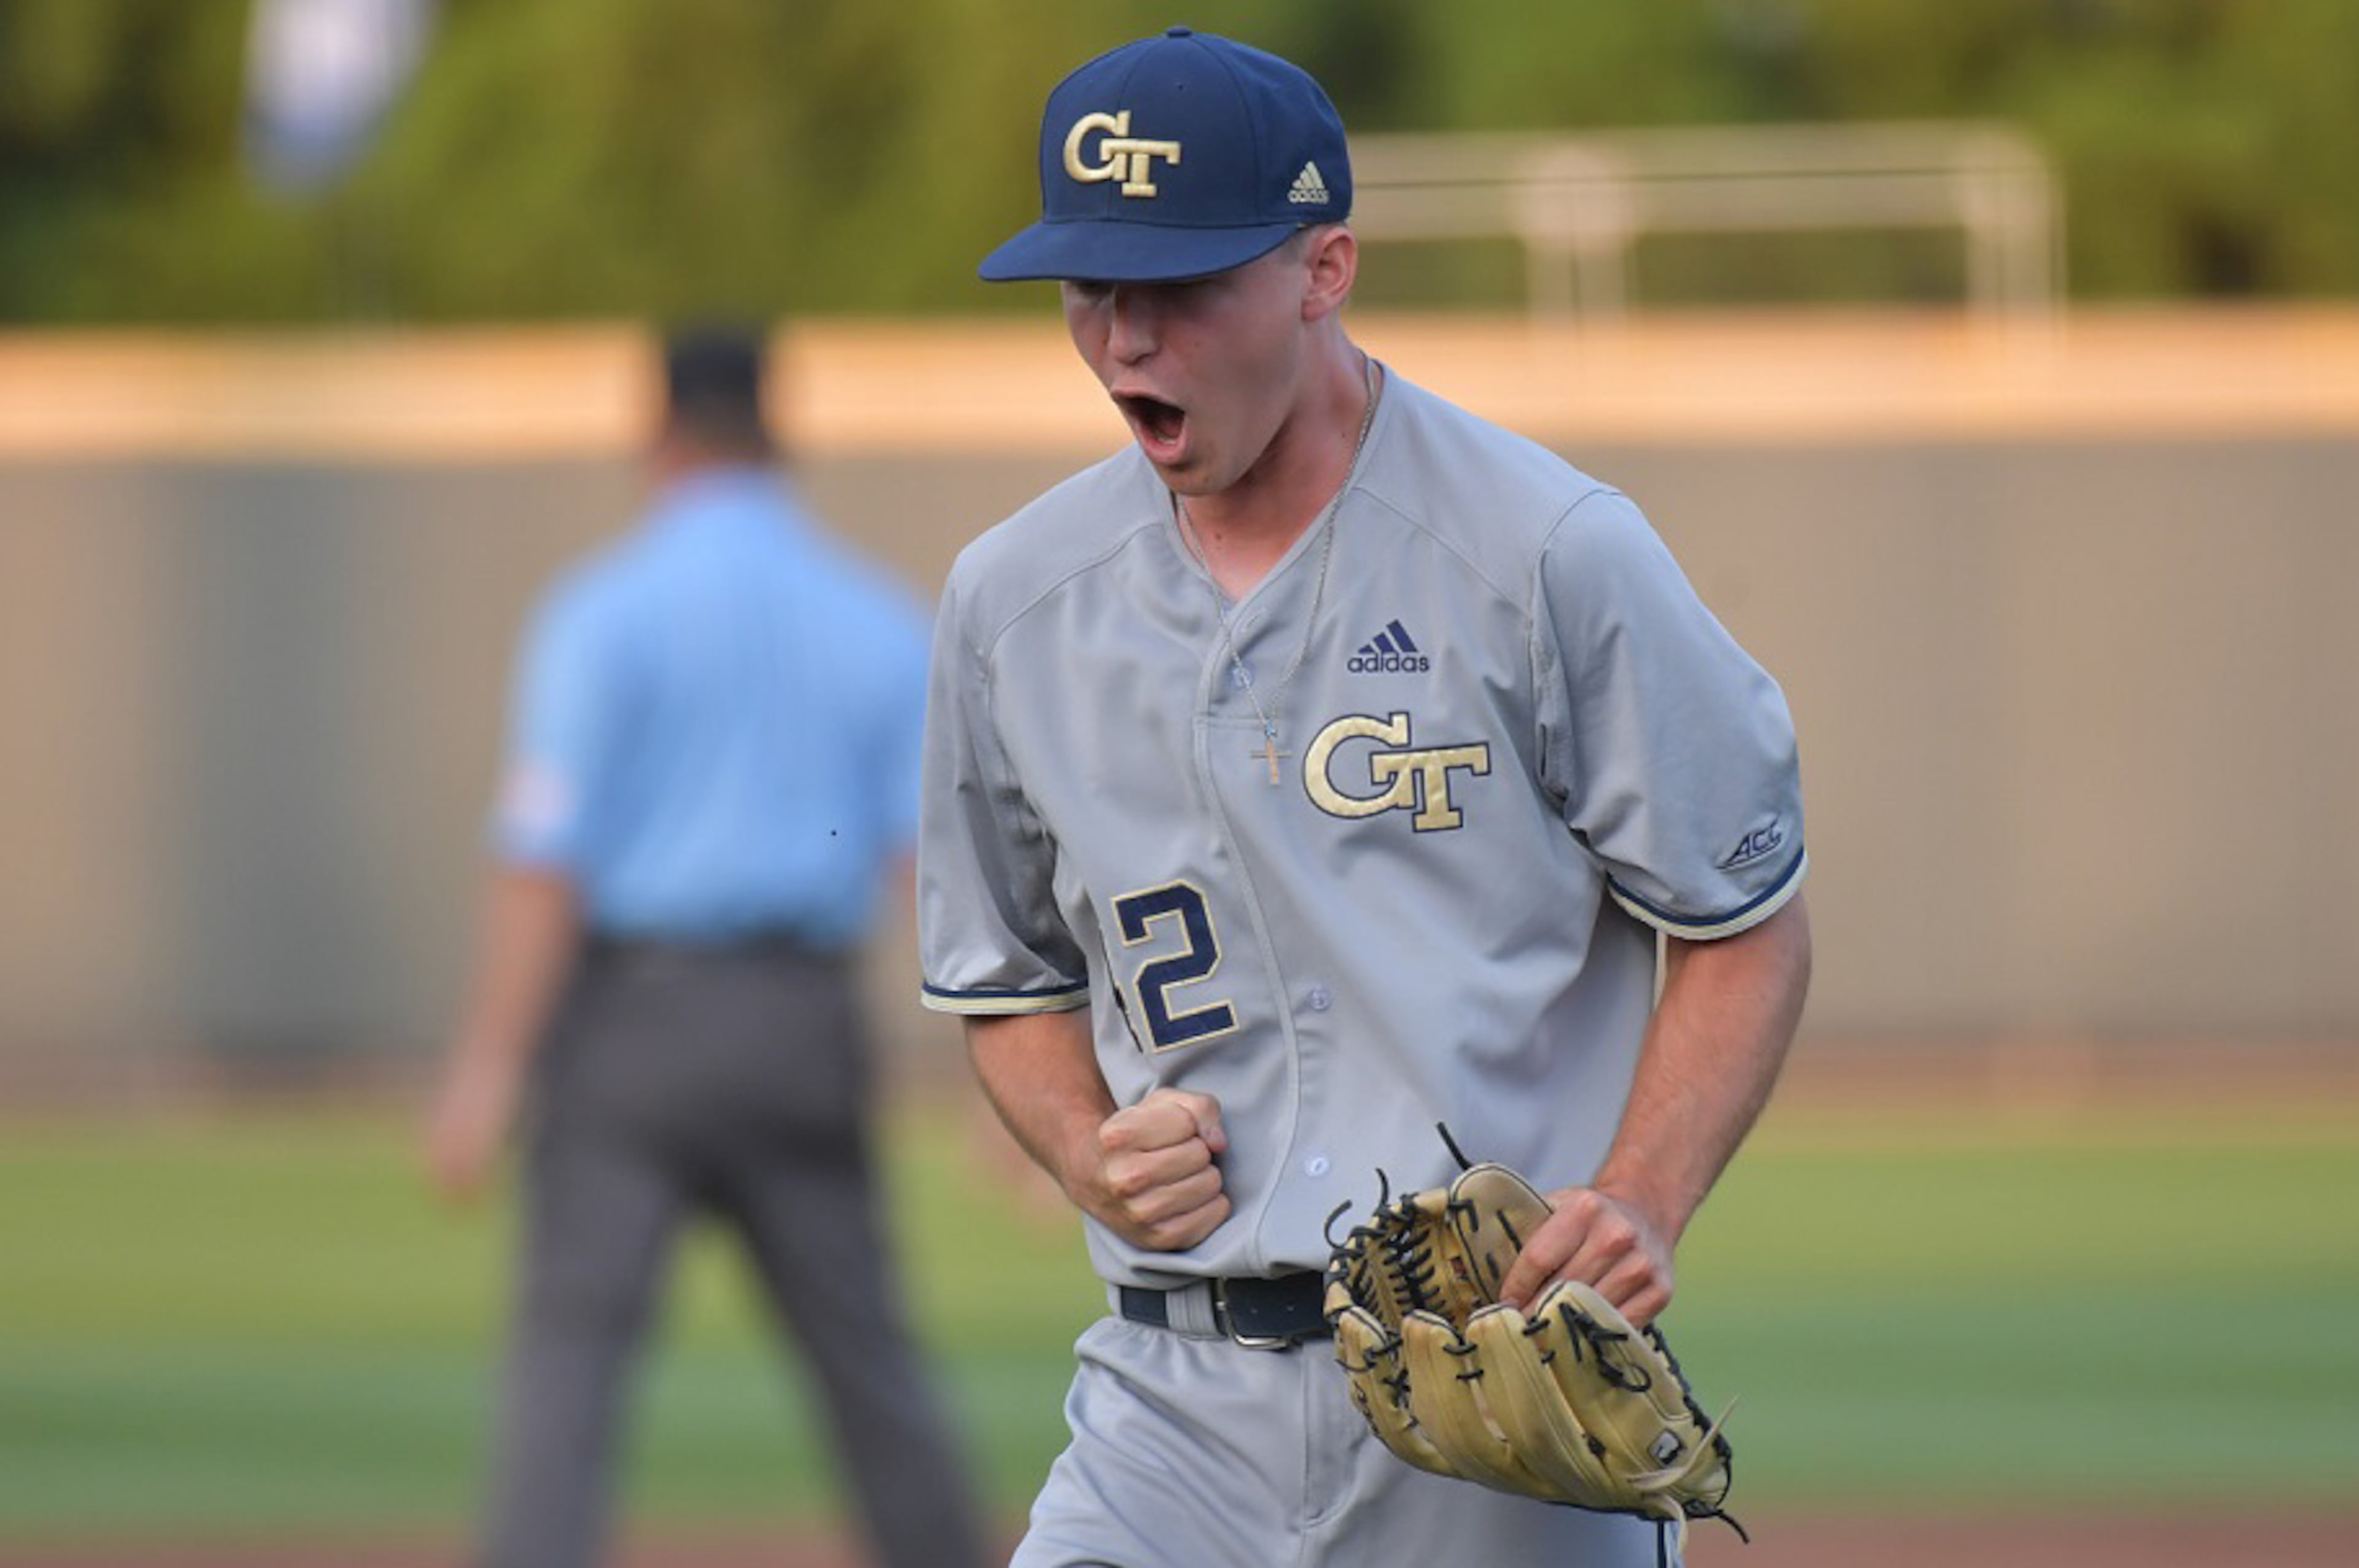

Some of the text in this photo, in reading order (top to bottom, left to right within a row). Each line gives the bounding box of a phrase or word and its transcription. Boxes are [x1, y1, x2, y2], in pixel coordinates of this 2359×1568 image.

[1063, 109, 1181, 198] GT
[1288, 189, 1329, 205] adidas
[1347, 651, 1430, 672] adidas
[1303, 711, 1492, 833] GT
[1111, 878, 1239, 1055] 2
